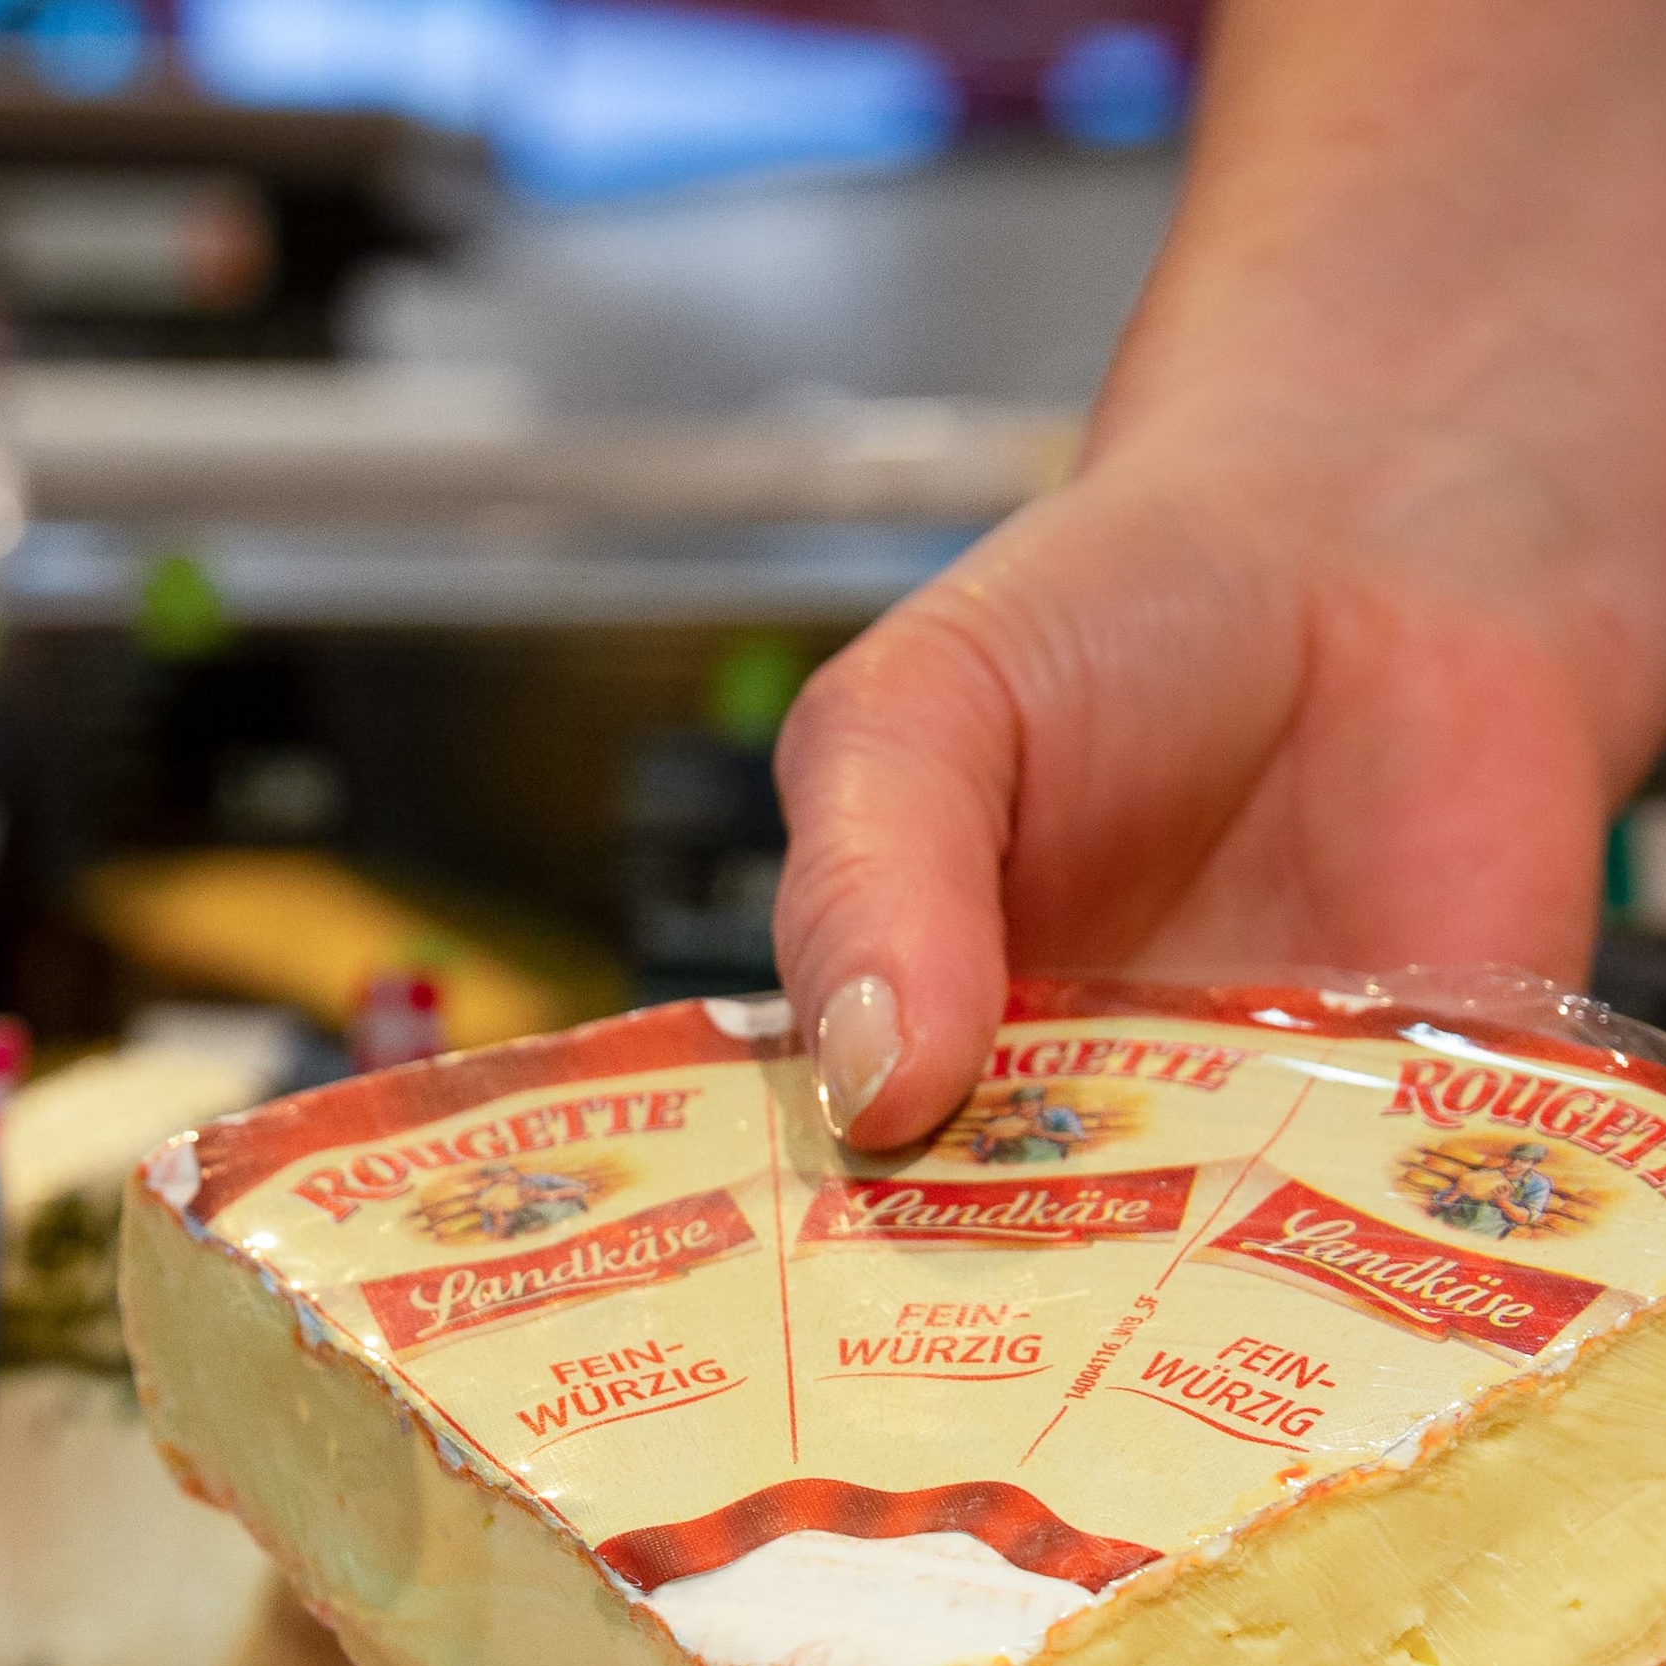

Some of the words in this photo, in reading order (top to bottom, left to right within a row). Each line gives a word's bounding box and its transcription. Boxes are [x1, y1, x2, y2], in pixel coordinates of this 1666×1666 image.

[293, 1088, 688, 1223] ROUGETTE
[829, 1188, 1151, 1238] Landkäse
[410, 1216, 715, 1338] Landkäse
[1240, 1209, 1536, 1328] Landkäse
[838, 1332, 1044, 1366] WÜRZIG
[895, 1303, 1033, 1328] FEIN-
[550, 1339, 685, 1385] FEIN-
[1140, 1349, 1325, 1437] WÜRZIG
[1216, 1335, 1337, 1391] FEIN-
[516, 1358, 729, 1437] WÜRZIG
